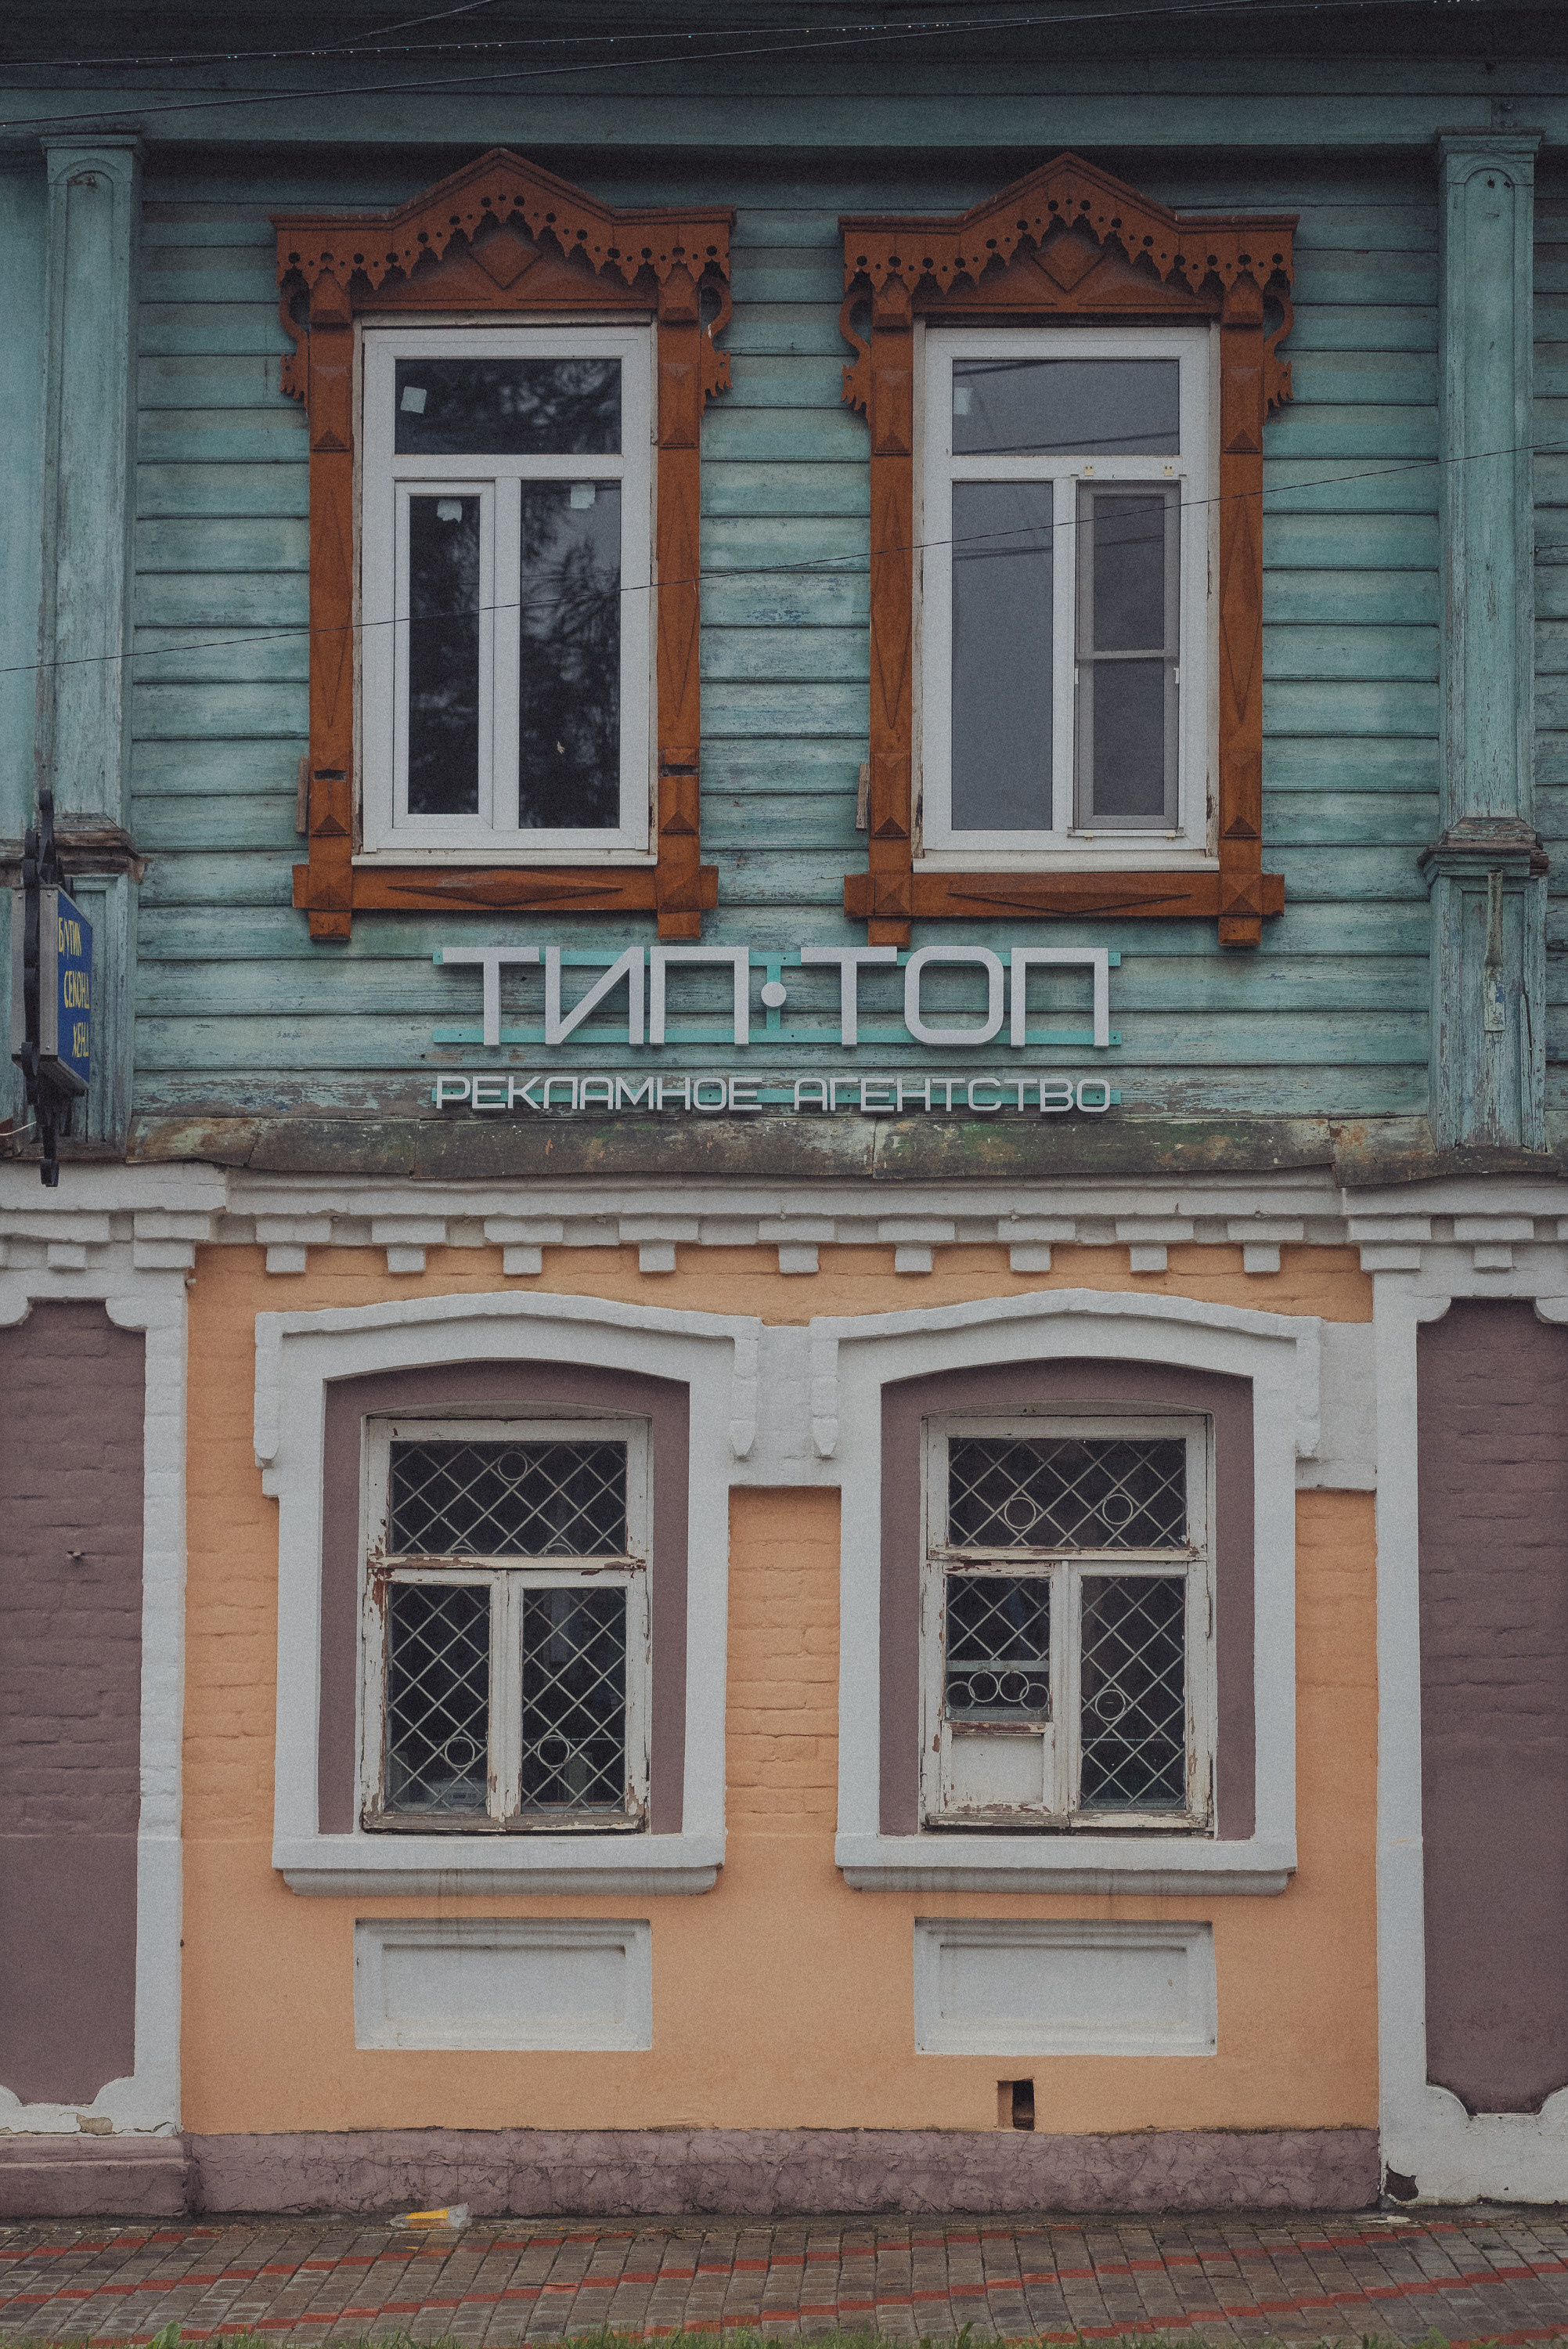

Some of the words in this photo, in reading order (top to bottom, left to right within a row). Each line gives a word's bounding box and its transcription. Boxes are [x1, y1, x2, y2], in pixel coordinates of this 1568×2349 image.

[63, 970, 90, 1009] СЕКОНД
[72, 1022, 89, 1057] ХЕНД
[436, 1075, 762, 1110] РЕКЛАМНОЕ
[794, 1077, 1112, 1112] АГЕНТСТВО
